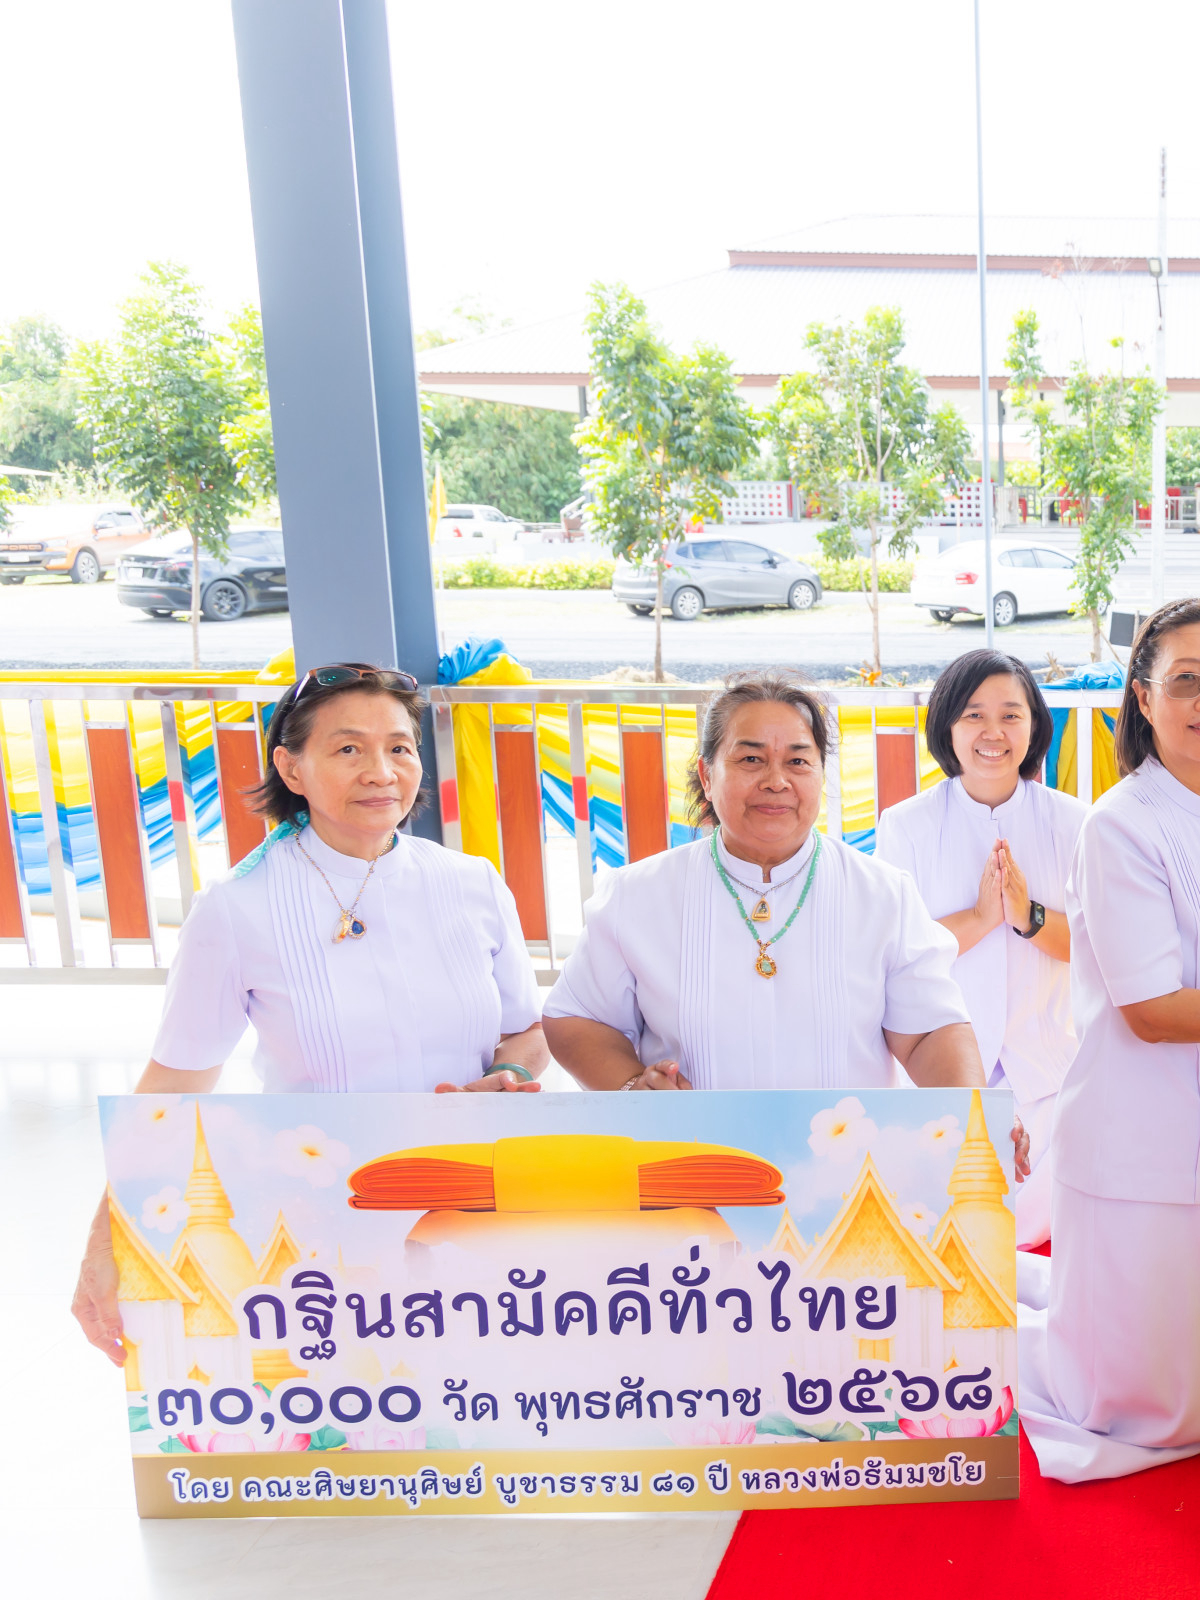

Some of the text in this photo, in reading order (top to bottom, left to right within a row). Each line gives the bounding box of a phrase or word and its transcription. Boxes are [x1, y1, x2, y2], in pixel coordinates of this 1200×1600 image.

[243, 1246, 898, 1360] กฐินสามัคคีทั่วไทย
[158, 1366, 993, 1437] ๓๐,๐๐๐ วัด พุทธศักราช ๒๕๖๘
[172, 1455, 983, 1508] โดย คณะศิษยานุศิษย์ บูชาธรรม ๘๑ ปี หลวงพ่อธัมมชโย
